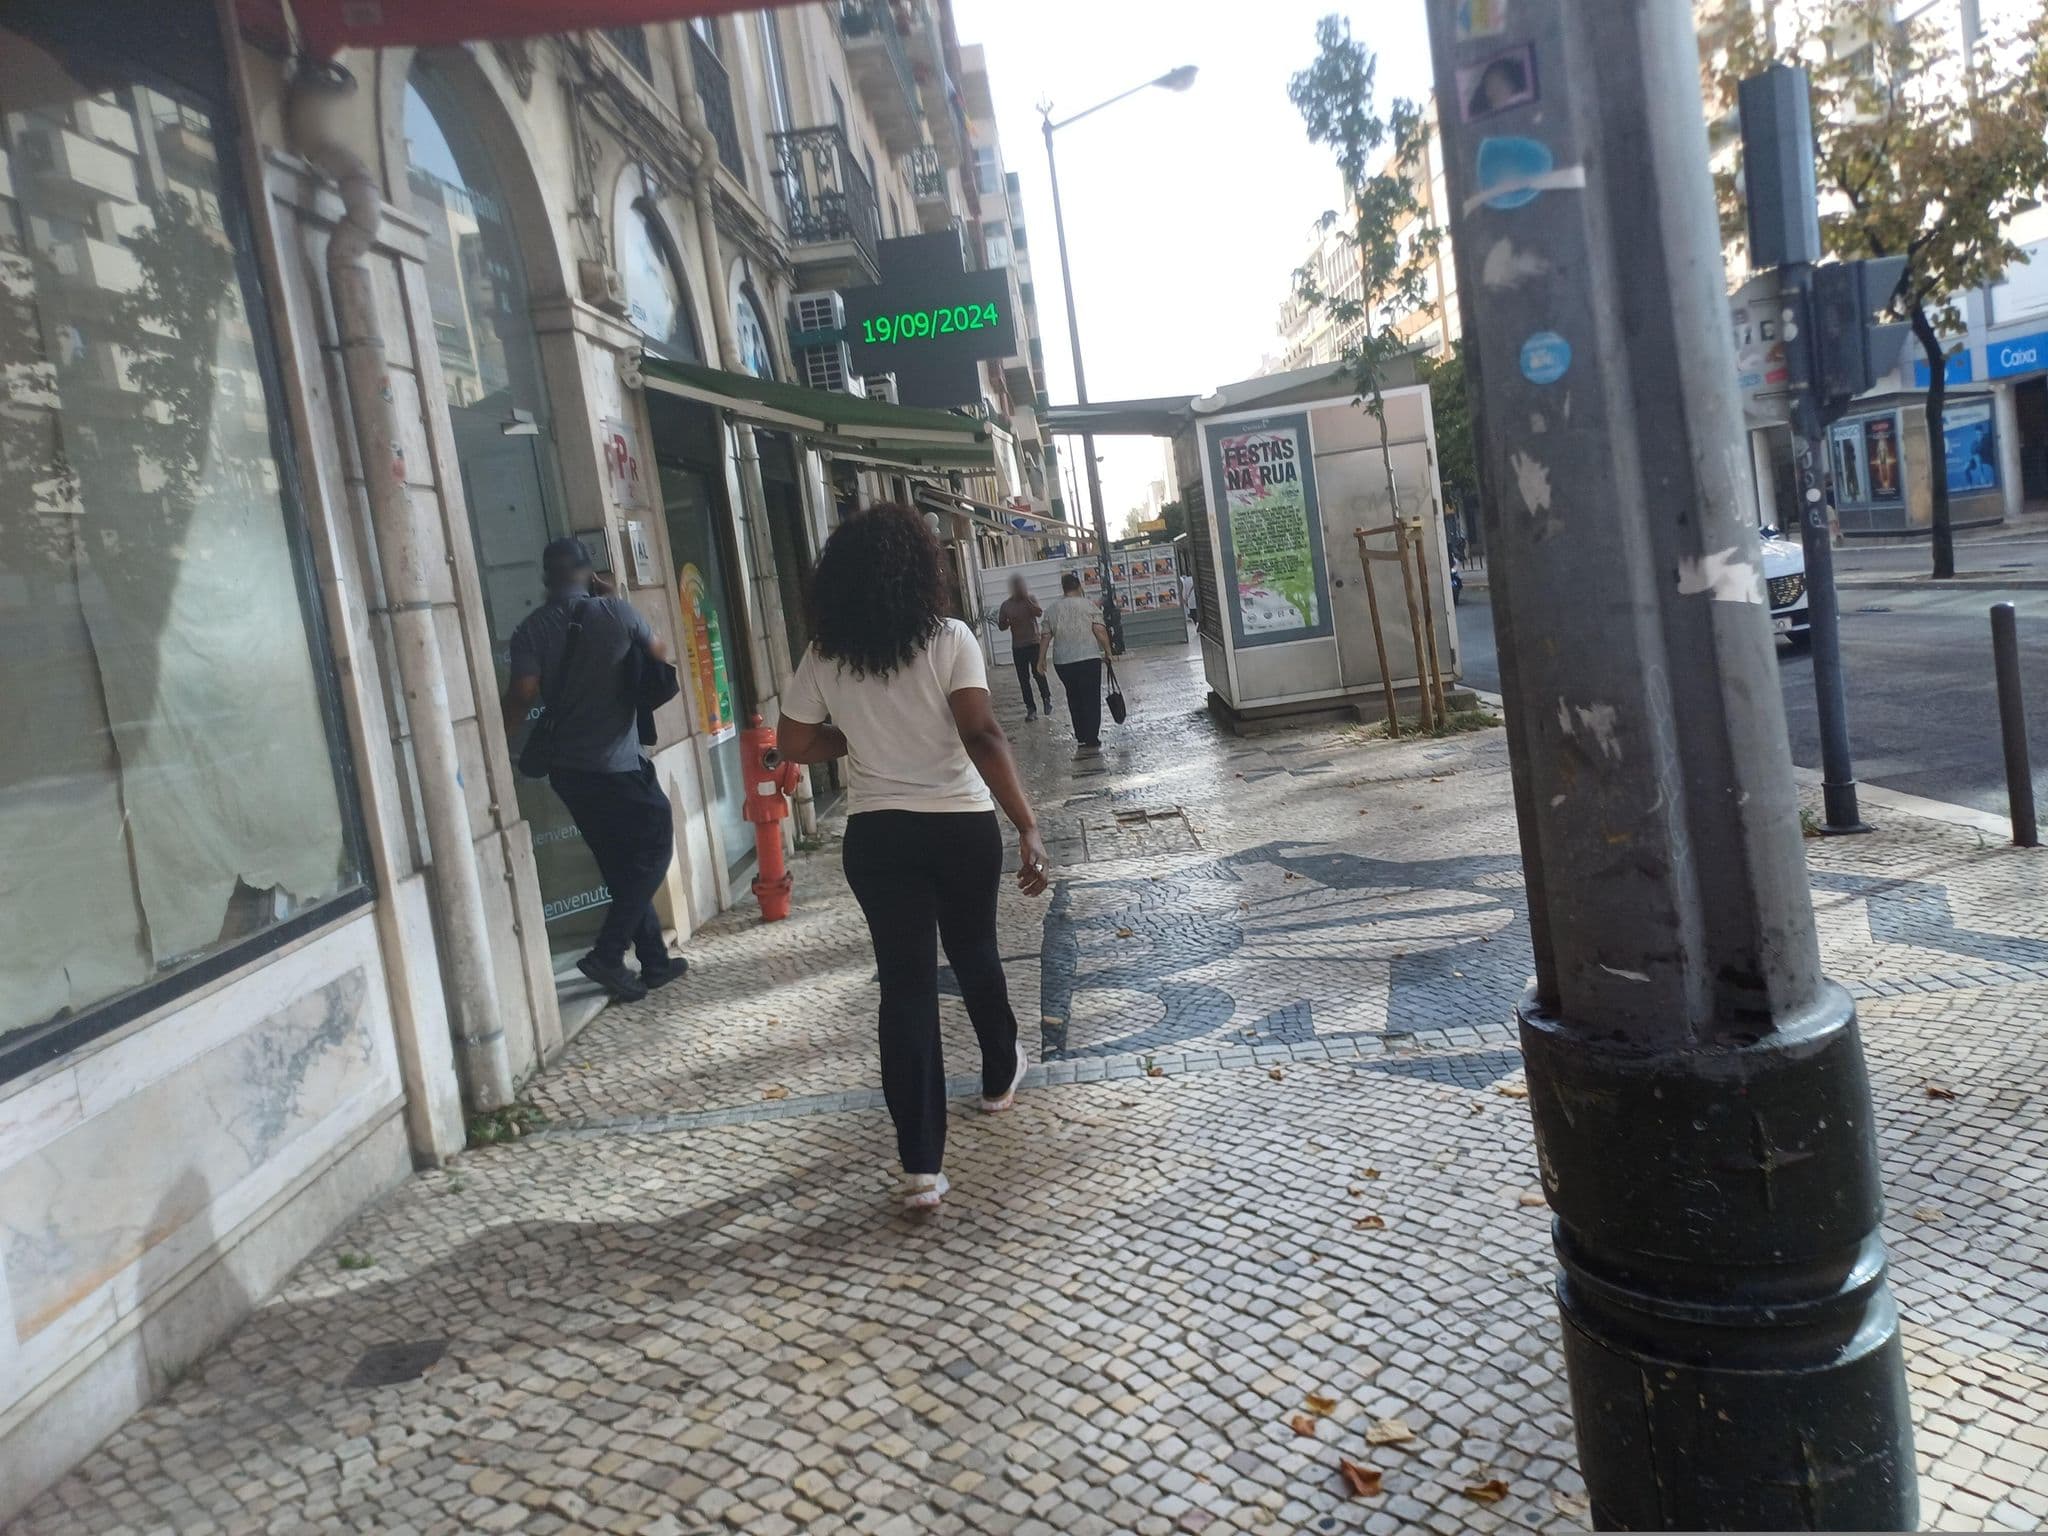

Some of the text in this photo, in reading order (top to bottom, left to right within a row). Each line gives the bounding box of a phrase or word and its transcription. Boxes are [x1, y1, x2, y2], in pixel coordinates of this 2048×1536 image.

[862, 302, 998, 344] 19/09/2024
[2001, 347, 2037, 368] Caixa
[1224, 438, 1294, 468] FESTAS
[1228, 462, 1297, 490] NA RUA
